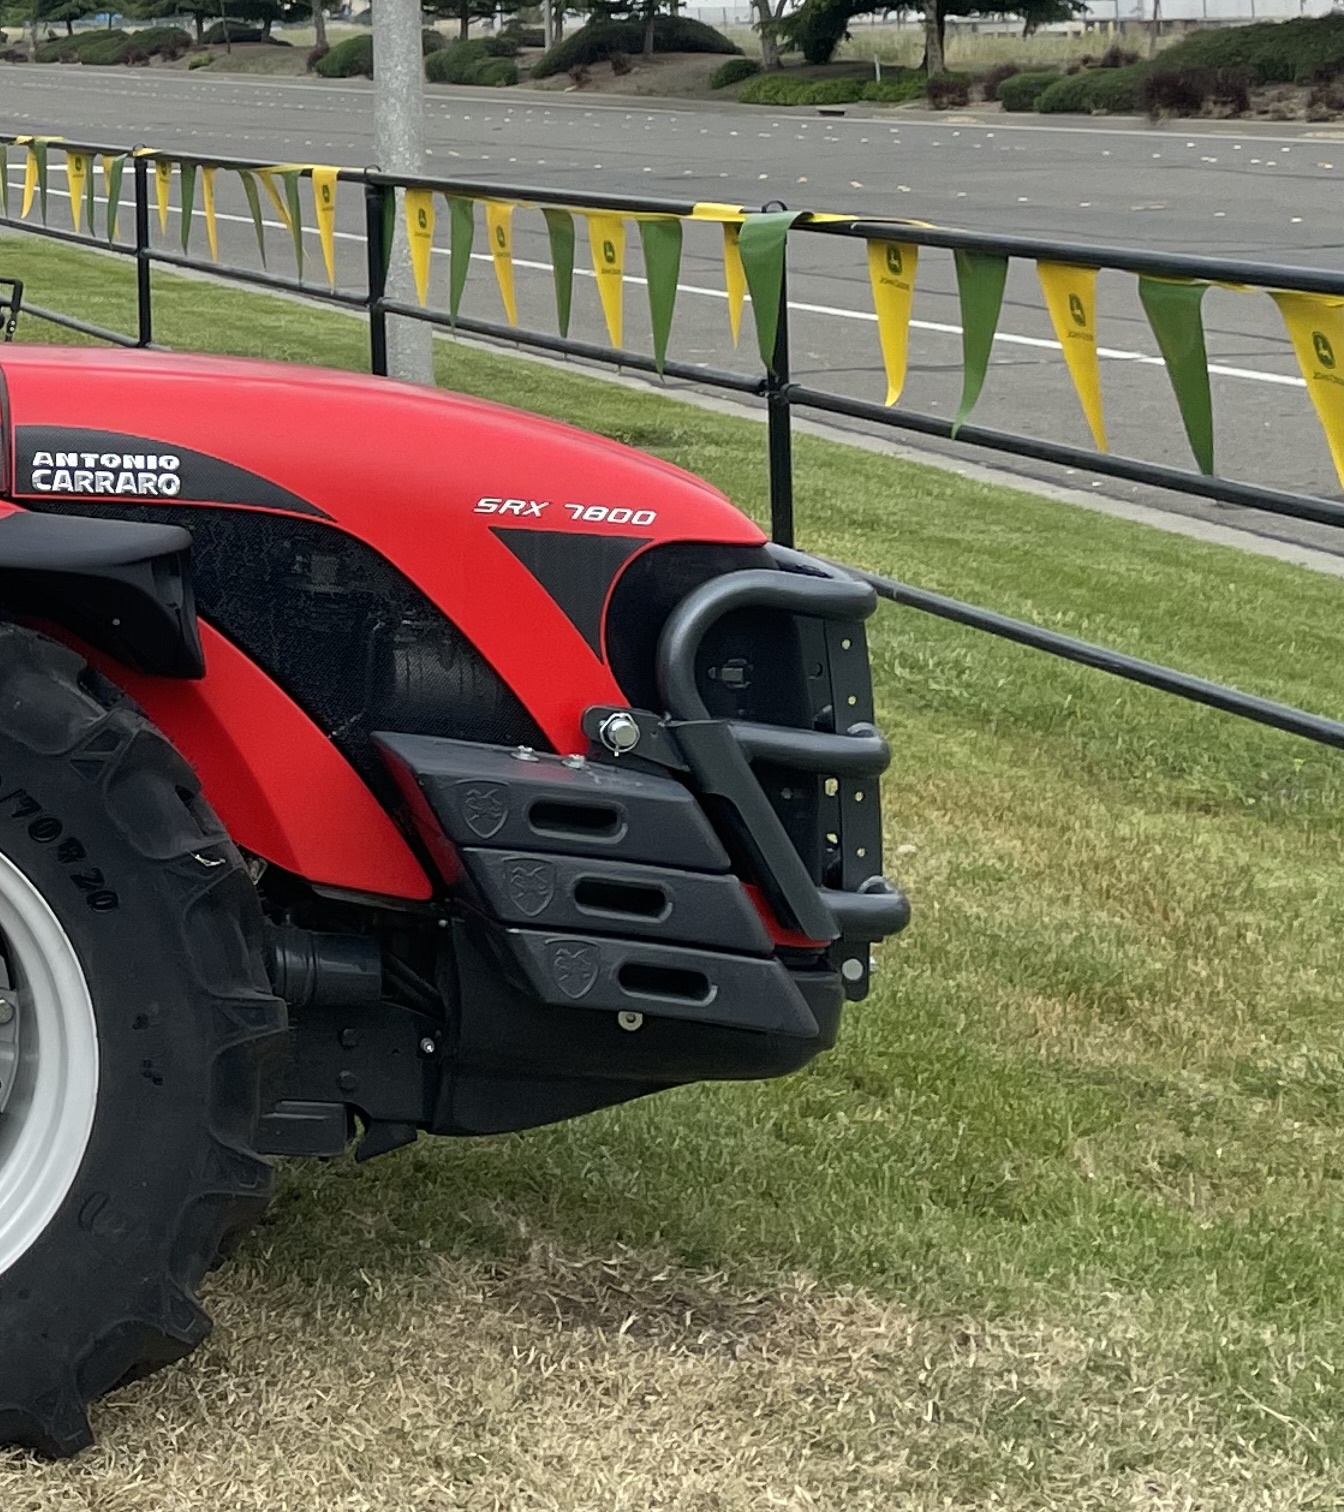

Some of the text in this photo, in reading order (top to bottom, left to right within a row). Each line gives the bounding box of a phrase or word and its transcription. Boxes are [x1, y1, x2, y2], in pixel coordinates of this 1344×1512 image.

[32, 451, 180, 470] ANTONIO
[31, 469, 181, 496] CARRARO
[473, 498, 657, 526] SRX 7800
